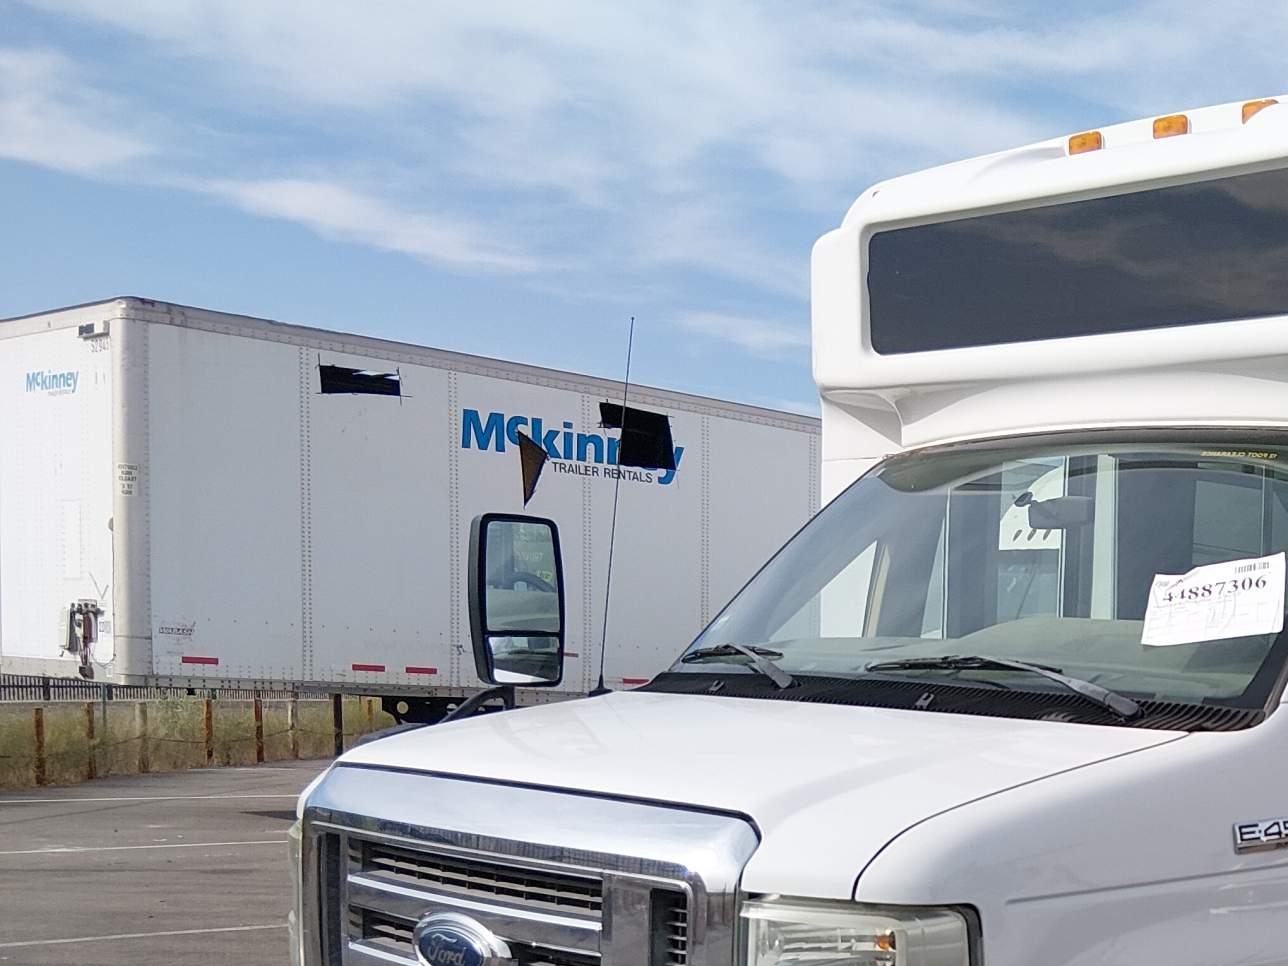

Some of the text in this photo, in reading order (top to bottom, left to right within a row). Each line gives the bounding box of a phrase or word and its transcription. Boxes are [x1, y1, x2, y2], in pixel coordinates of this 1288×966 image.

[461, 408, 685, 485] Mckiny
[552, 461, 653, 484] TRAILER RENTALS
[1163, 574, 1267, 603] 44887306
